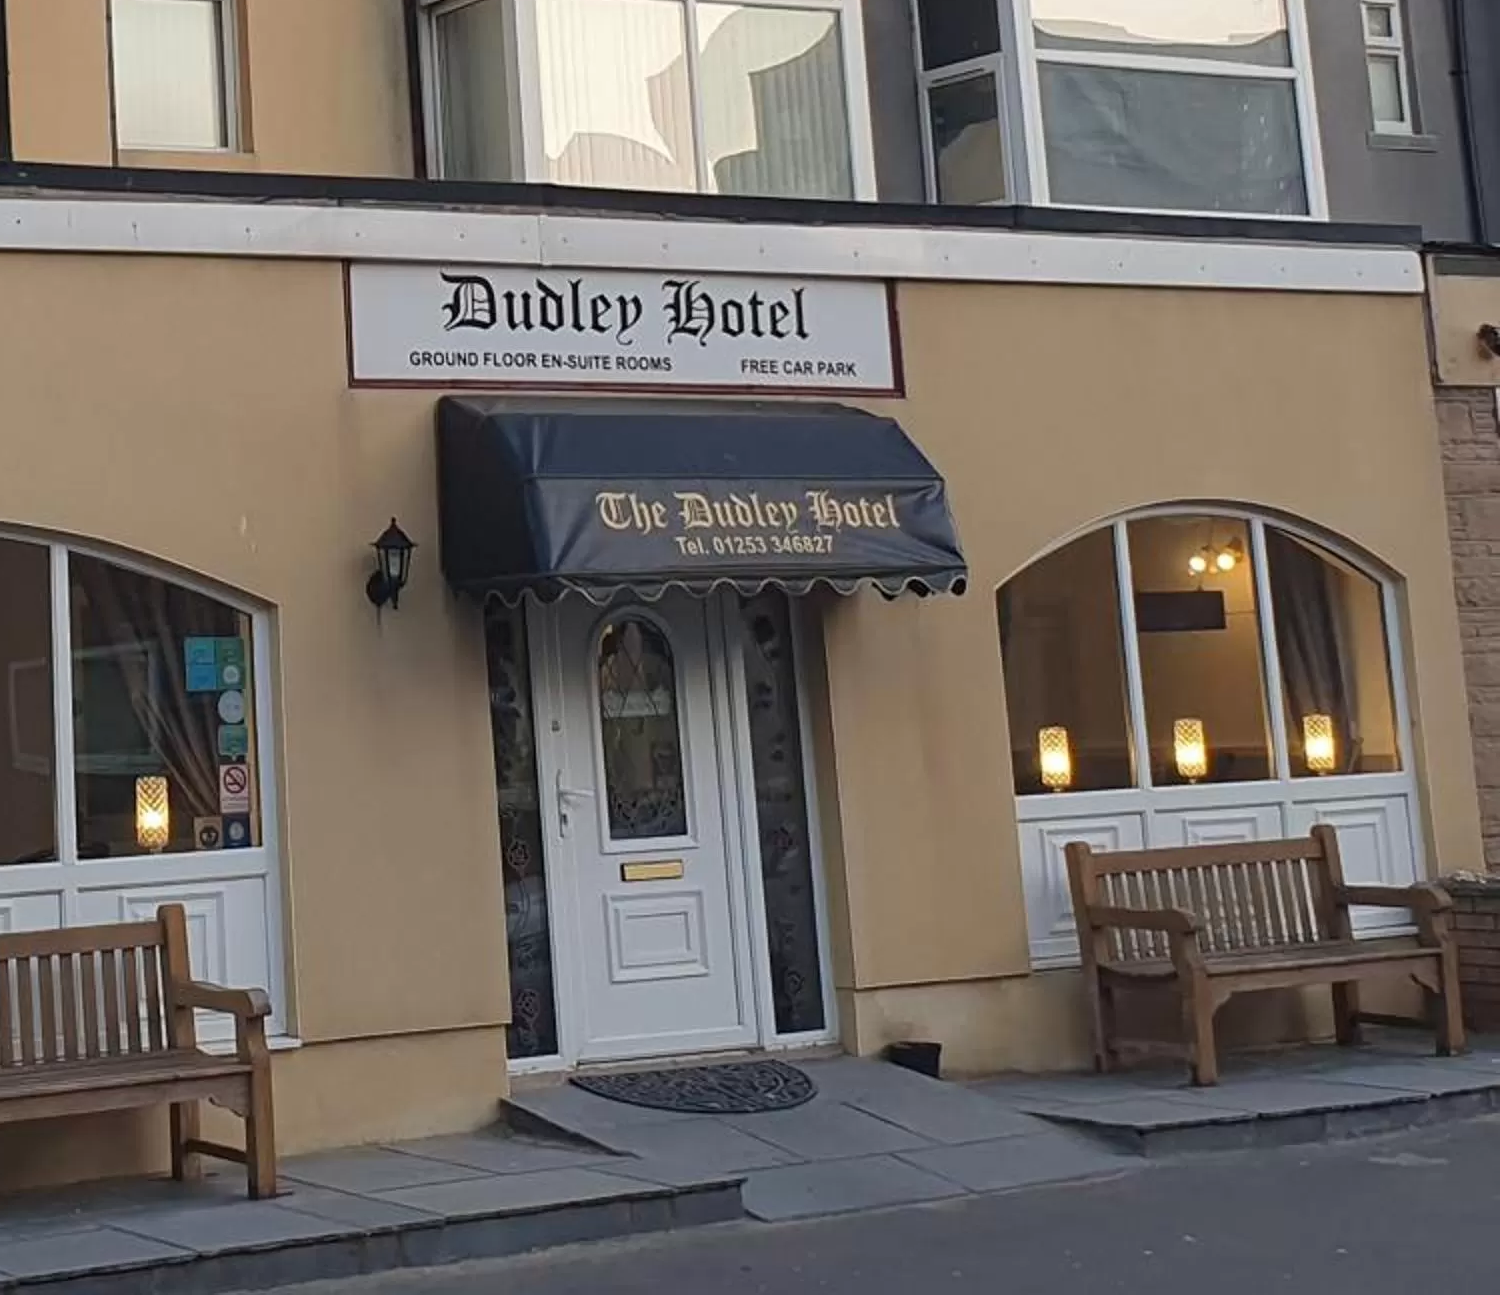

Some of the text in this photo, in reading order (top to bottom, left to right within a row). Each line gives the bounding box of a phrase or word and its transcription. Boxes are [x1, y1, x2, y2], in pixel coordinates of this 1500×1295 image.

[439, 270, 810, 347] Dudley Hotel
[409, 351, 673, 372] GROUND FLOOR EN-SUITE ROOMS
[741, 358, 857, 377] FREE CAR PARK
[595, 489, 901, 535] The Dudley Hotel
[675, 534, 834, 555] Tel. 01253 346827
